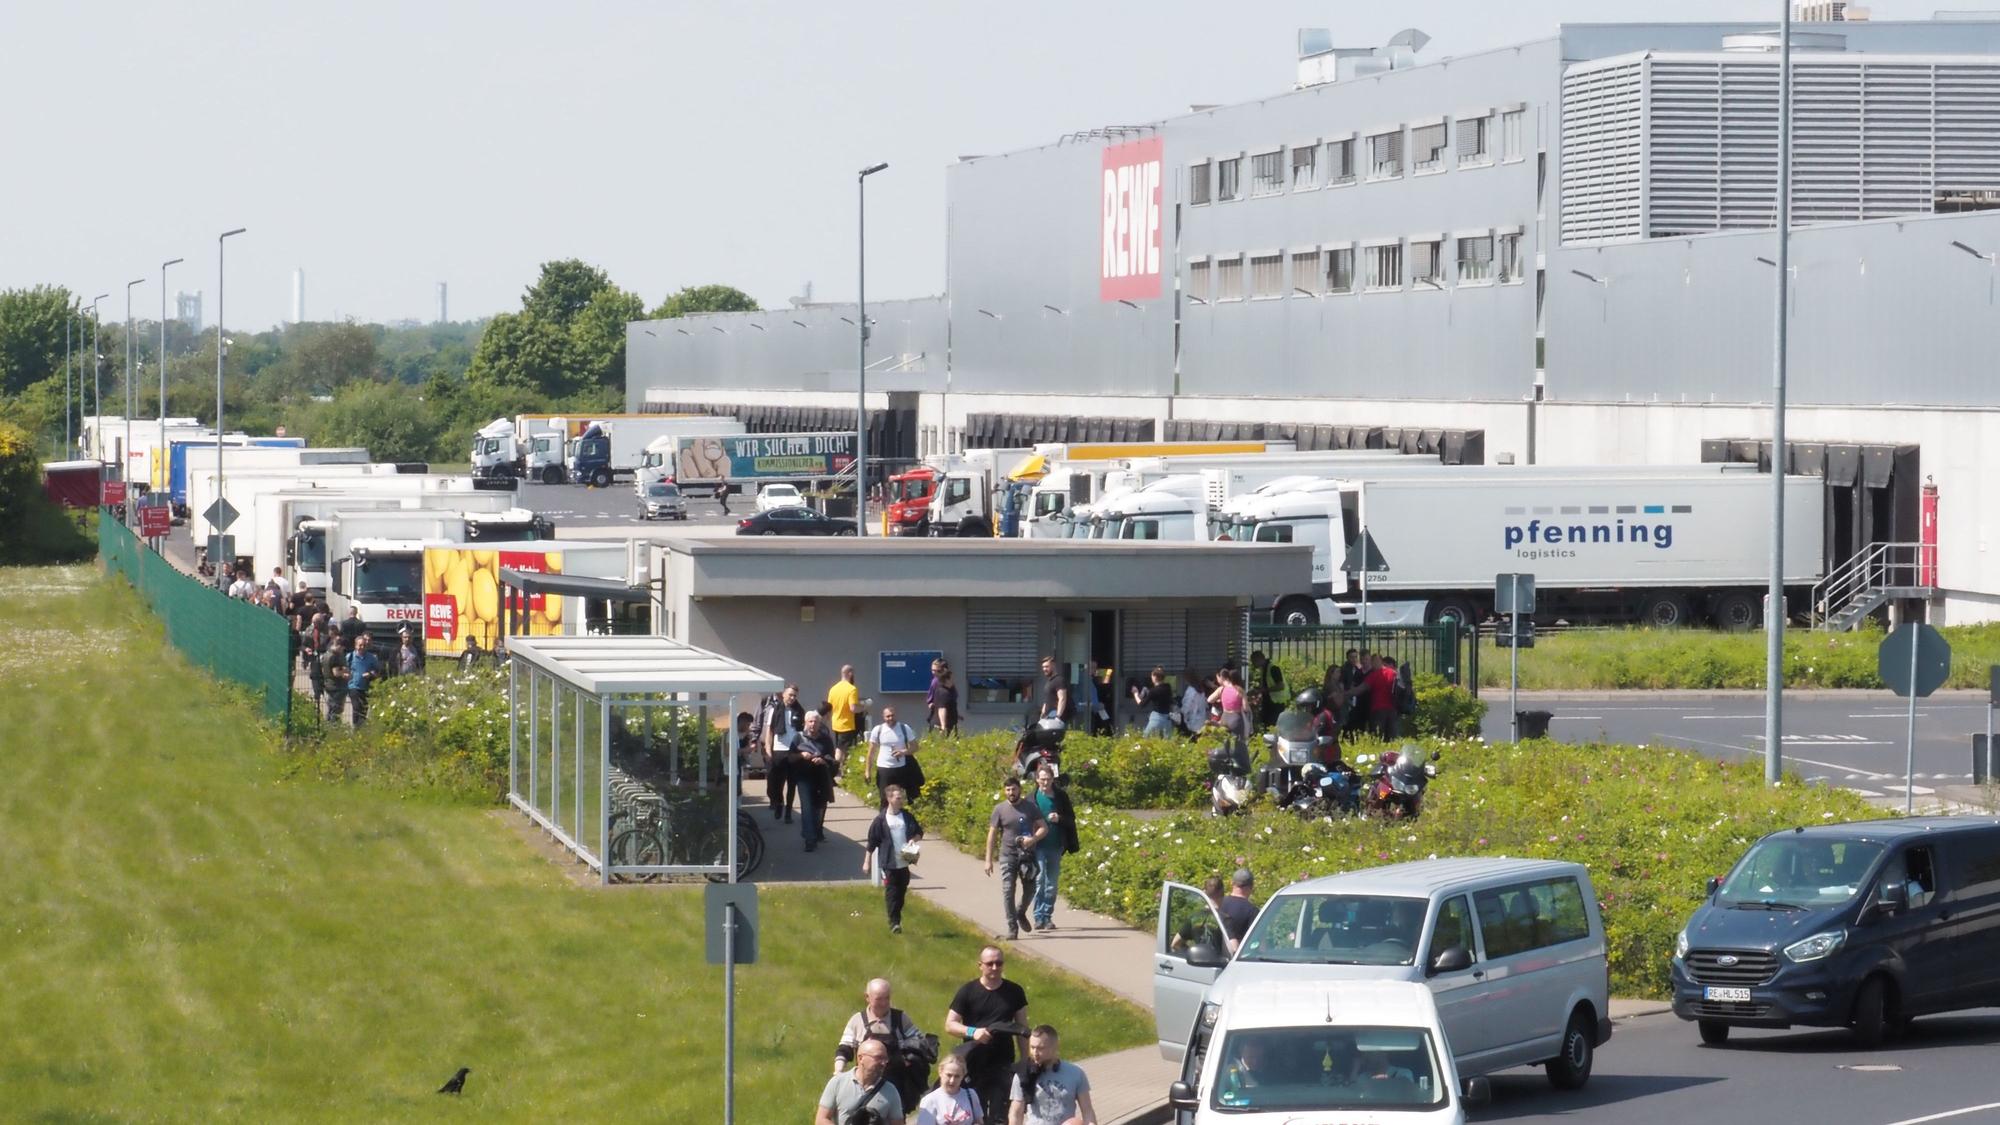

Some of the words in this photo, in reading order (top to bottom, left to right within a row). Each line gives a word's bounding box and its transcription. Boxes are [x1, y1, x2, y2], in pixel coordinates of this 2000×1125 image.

[1103, 161, 1160, 278] REWE
[735, 439, 759, 457] WIR
[765, 437, 809, 456] SUCHEN
[815, 436, 850, 454] DICH!
[1505, 519, 1672, 550] pfenning
[1517, 550, 1576, 560] logistics
[387, 608, 423, 619] REWE
[430, 604, 452, 619] REWE
[1734, 989, 1750, 999] 515
